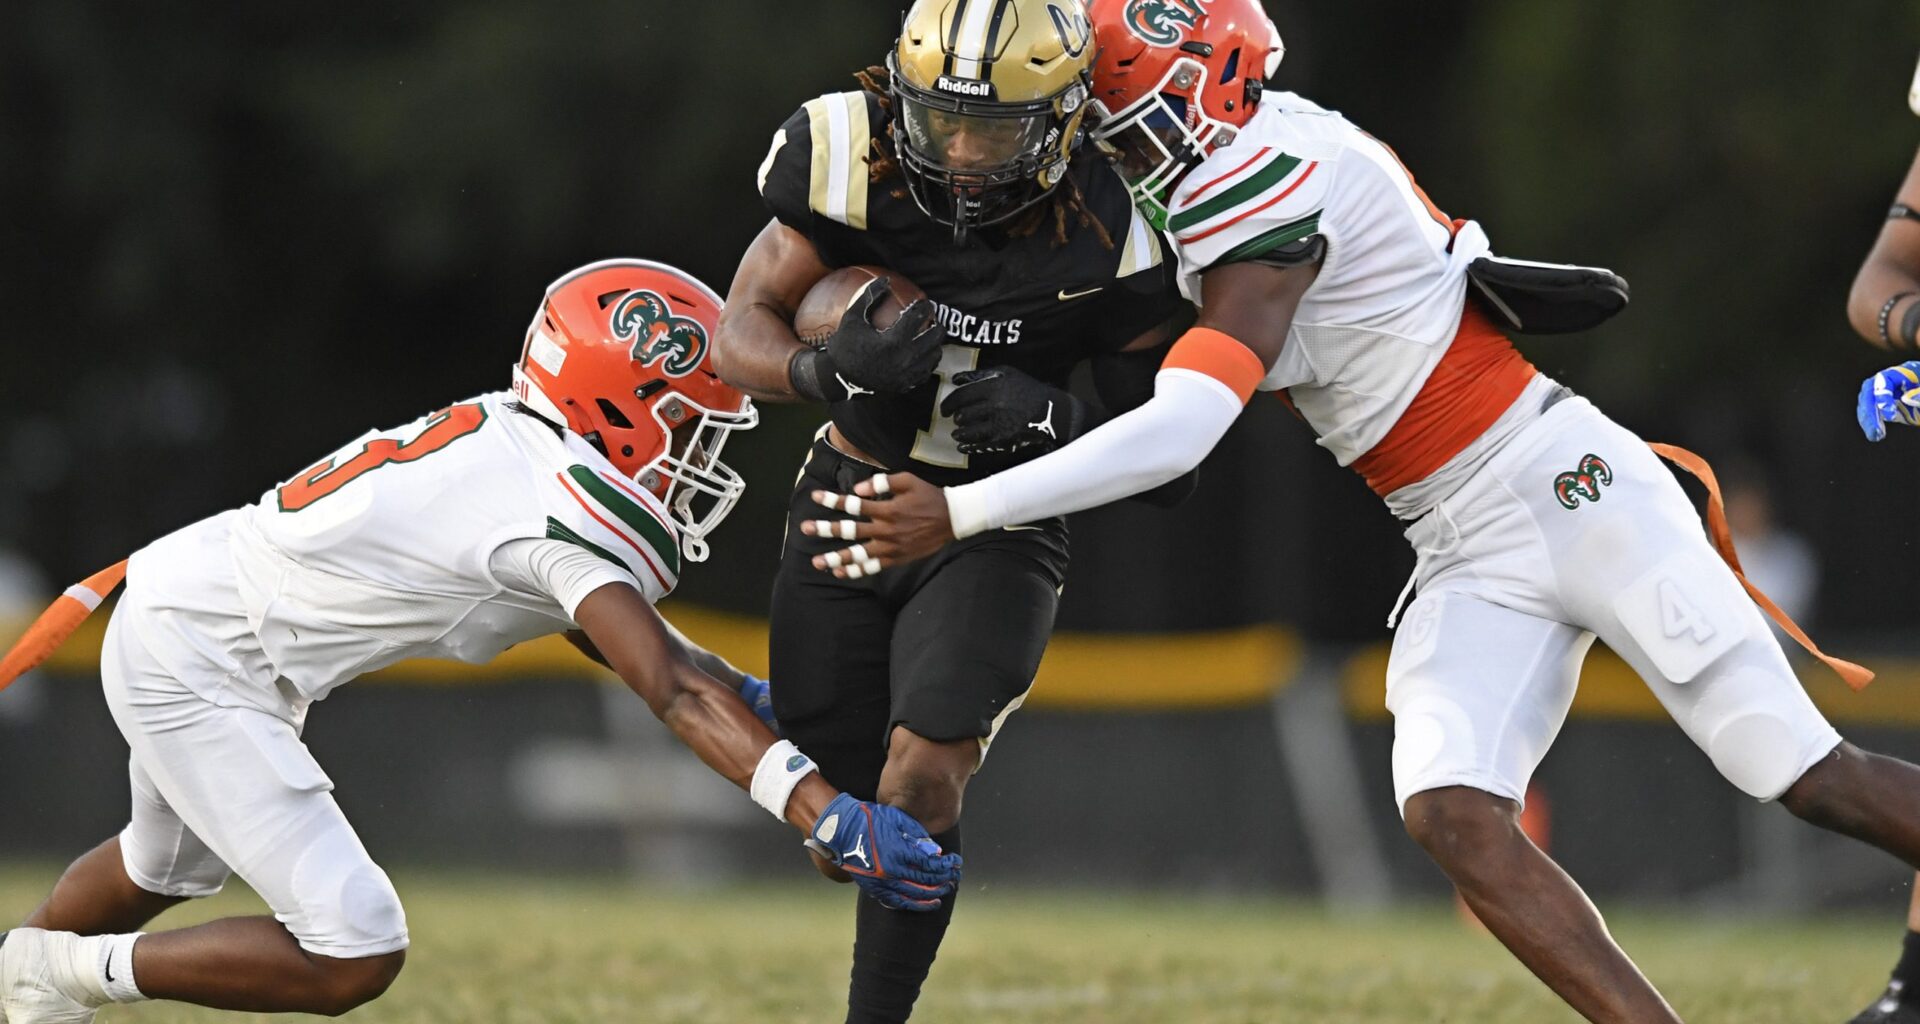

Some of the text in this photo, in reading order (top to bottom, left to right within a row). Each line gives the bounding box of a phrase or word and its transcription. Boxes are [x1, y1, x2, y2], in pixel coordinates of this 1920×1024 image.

[938, 77, 990, 96] Riddell
[929, 299, 1023, 345] OBCATS
[909, 343, 982, 469] 1
[277, 402, 489, 513] 3
